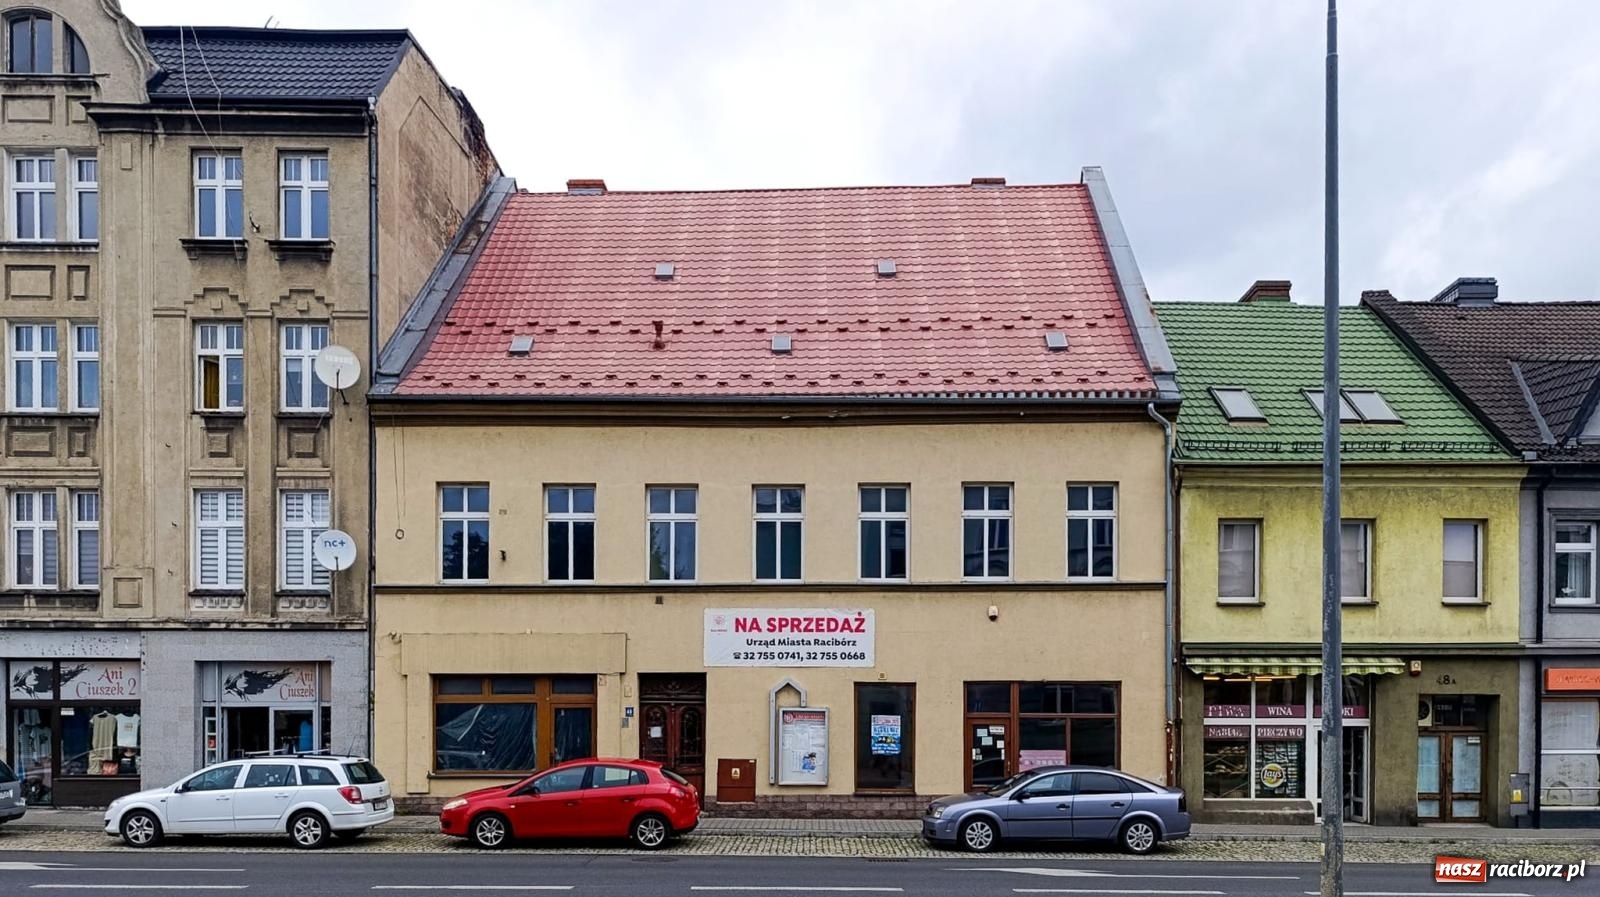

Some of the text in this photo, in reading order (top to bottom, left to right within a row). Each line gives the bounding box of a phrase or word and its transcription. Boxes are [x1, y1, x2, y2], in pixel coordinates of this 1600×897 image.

[324, 539, 346, 548] nc+
[734, 611, 866, 633] NA SPRZEDAŻ
[746, 638, 857, 648] Urząd Miasta Racibórz
[743, 652, 866, 662] 32 755 0741, 32 755 0668
[98, 666, 123, 683] Ani
[295, 670, 313, 685] Ani
[76, 677, 137, 698] Ciuszek 2
[279, 684, 315, 700] Ciuszek
[1208, 705, 1244, 717] PIWA
[1267, 706, 1293, 716] WINA
[1341, 707, 1354, 716] KI
[1257, 728, 1303, 737] PIECZYWO
